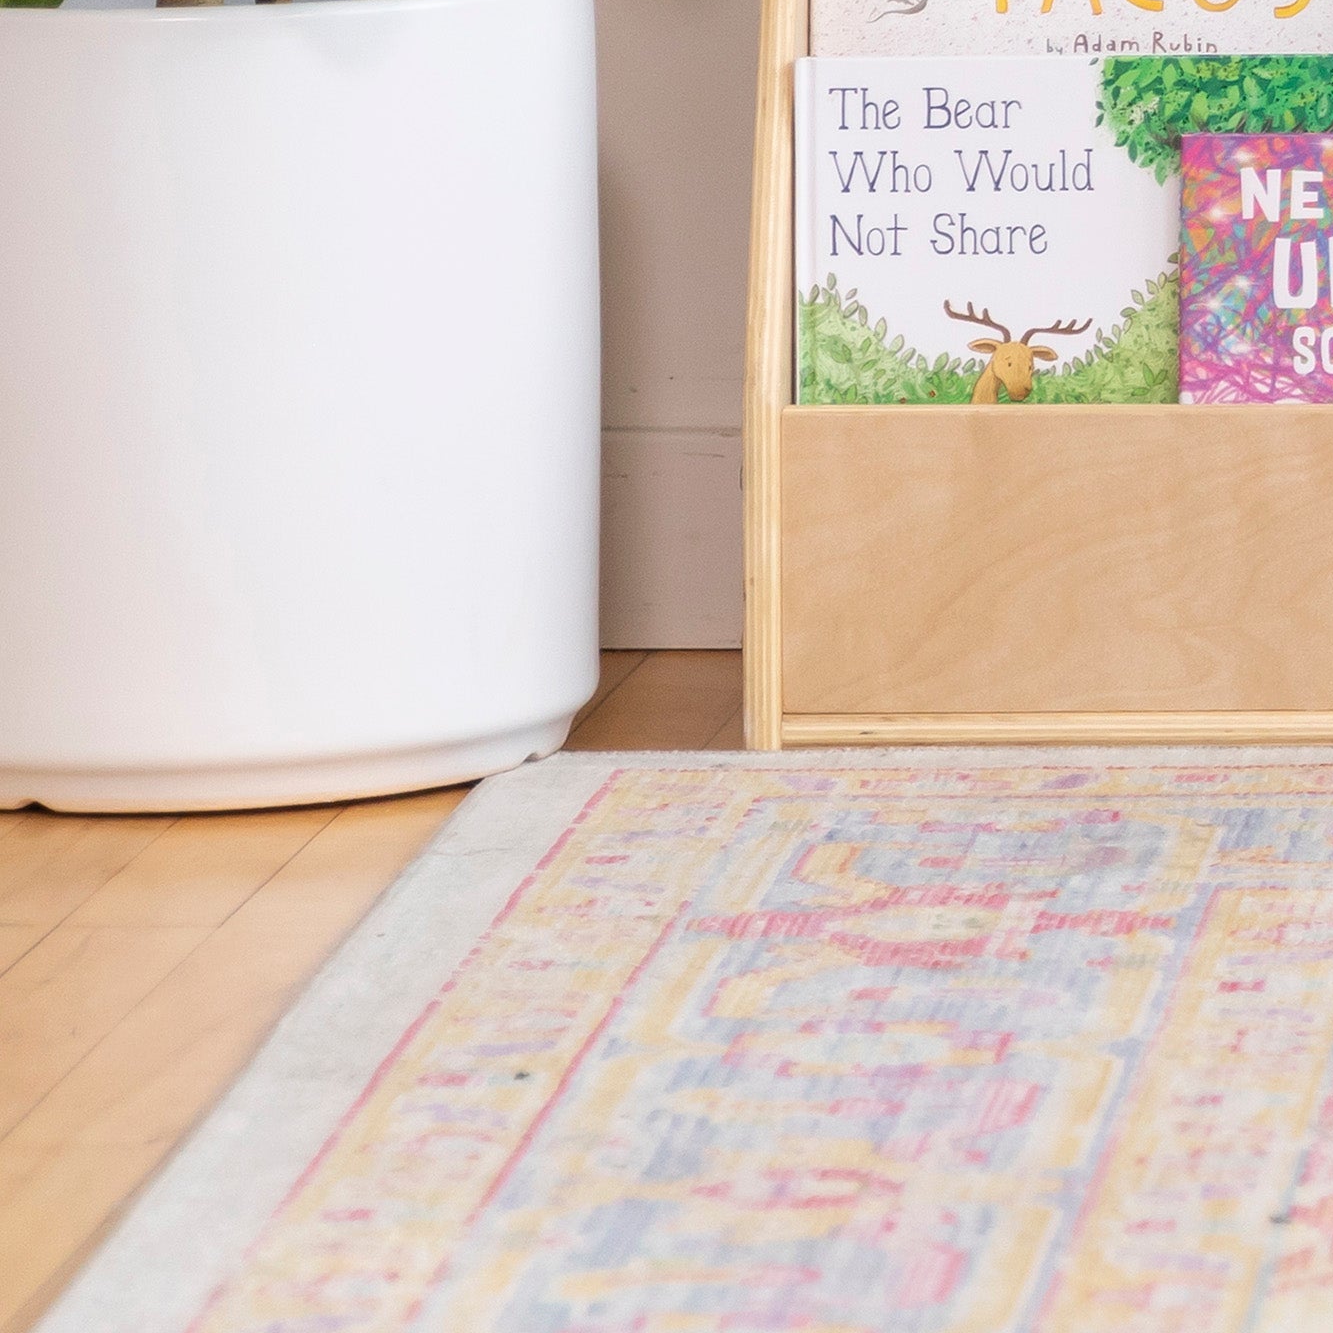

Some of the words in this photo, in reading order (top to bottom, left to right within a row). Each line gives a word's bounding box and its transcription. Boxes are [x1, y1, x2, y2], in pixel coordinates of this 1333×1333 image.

[1047, 38, 1063, 55] by
[1074, 34, 1139, 53] Adam
[1153, 32, 1217, 54] Rubin
[829, 87, 901, 130] The
[923, 87, 1022, 129] Bear
[829, 151, 932, 193] Who
[954, 149, 1095, 192] Would
[830, 213, 908, 257] Not
[930, 213, 1048, 255] Share
